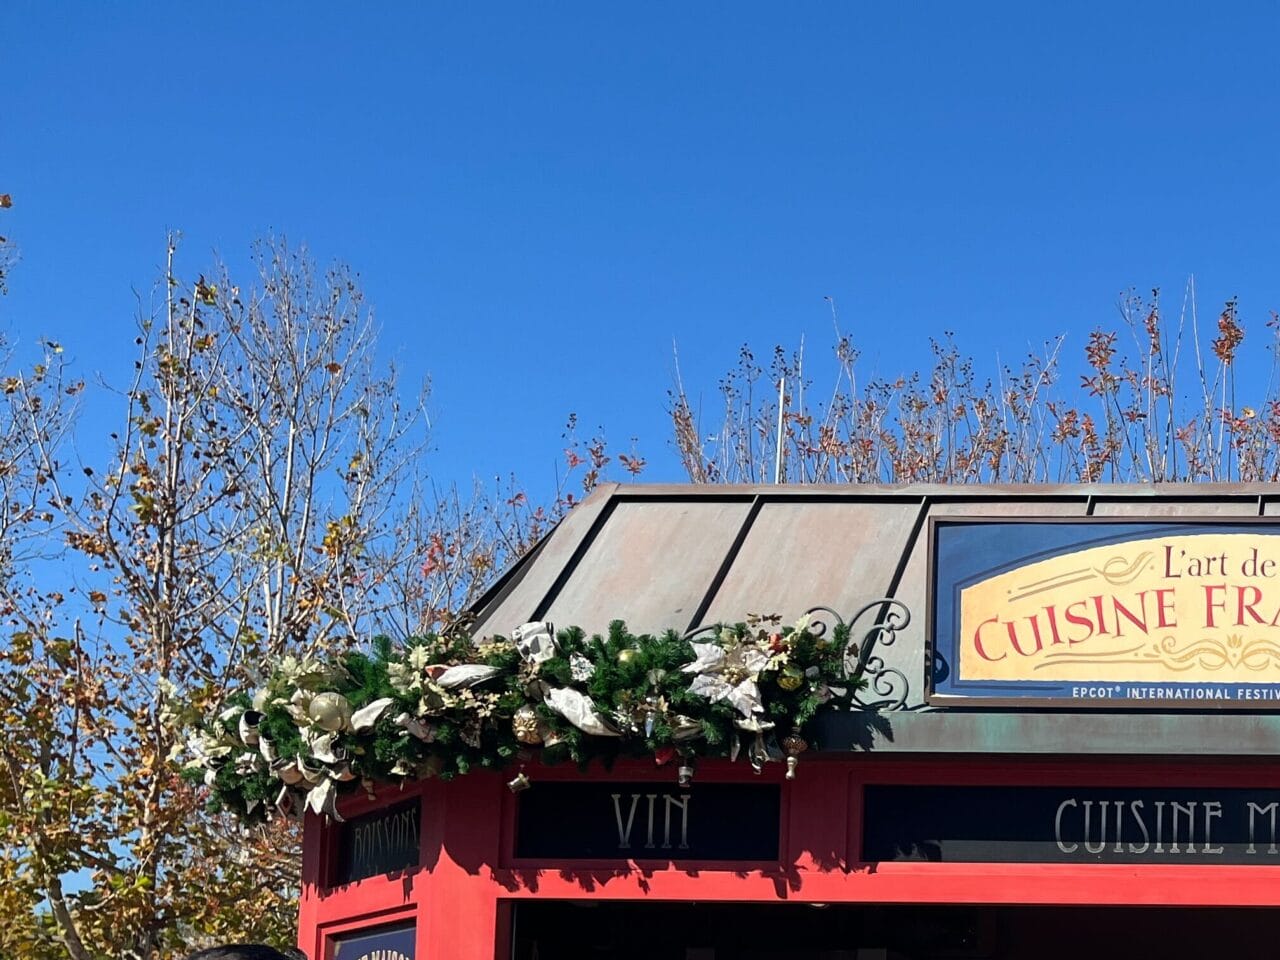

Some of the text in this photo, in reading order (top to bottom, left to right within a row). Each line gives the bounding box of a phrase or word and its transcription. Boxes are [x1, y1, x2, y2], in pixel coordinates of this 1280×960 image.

[1162, 545, 1229, 579] L'art
[1241, 547, 1276, 578] de
[973, 585, 1178, 662] CUISINE
[1127, 687, 1231, 700] INTERNATIONAL
[611, 793, 691, 848] VIN
[1055, 798, 1225, 854] CUISINE
